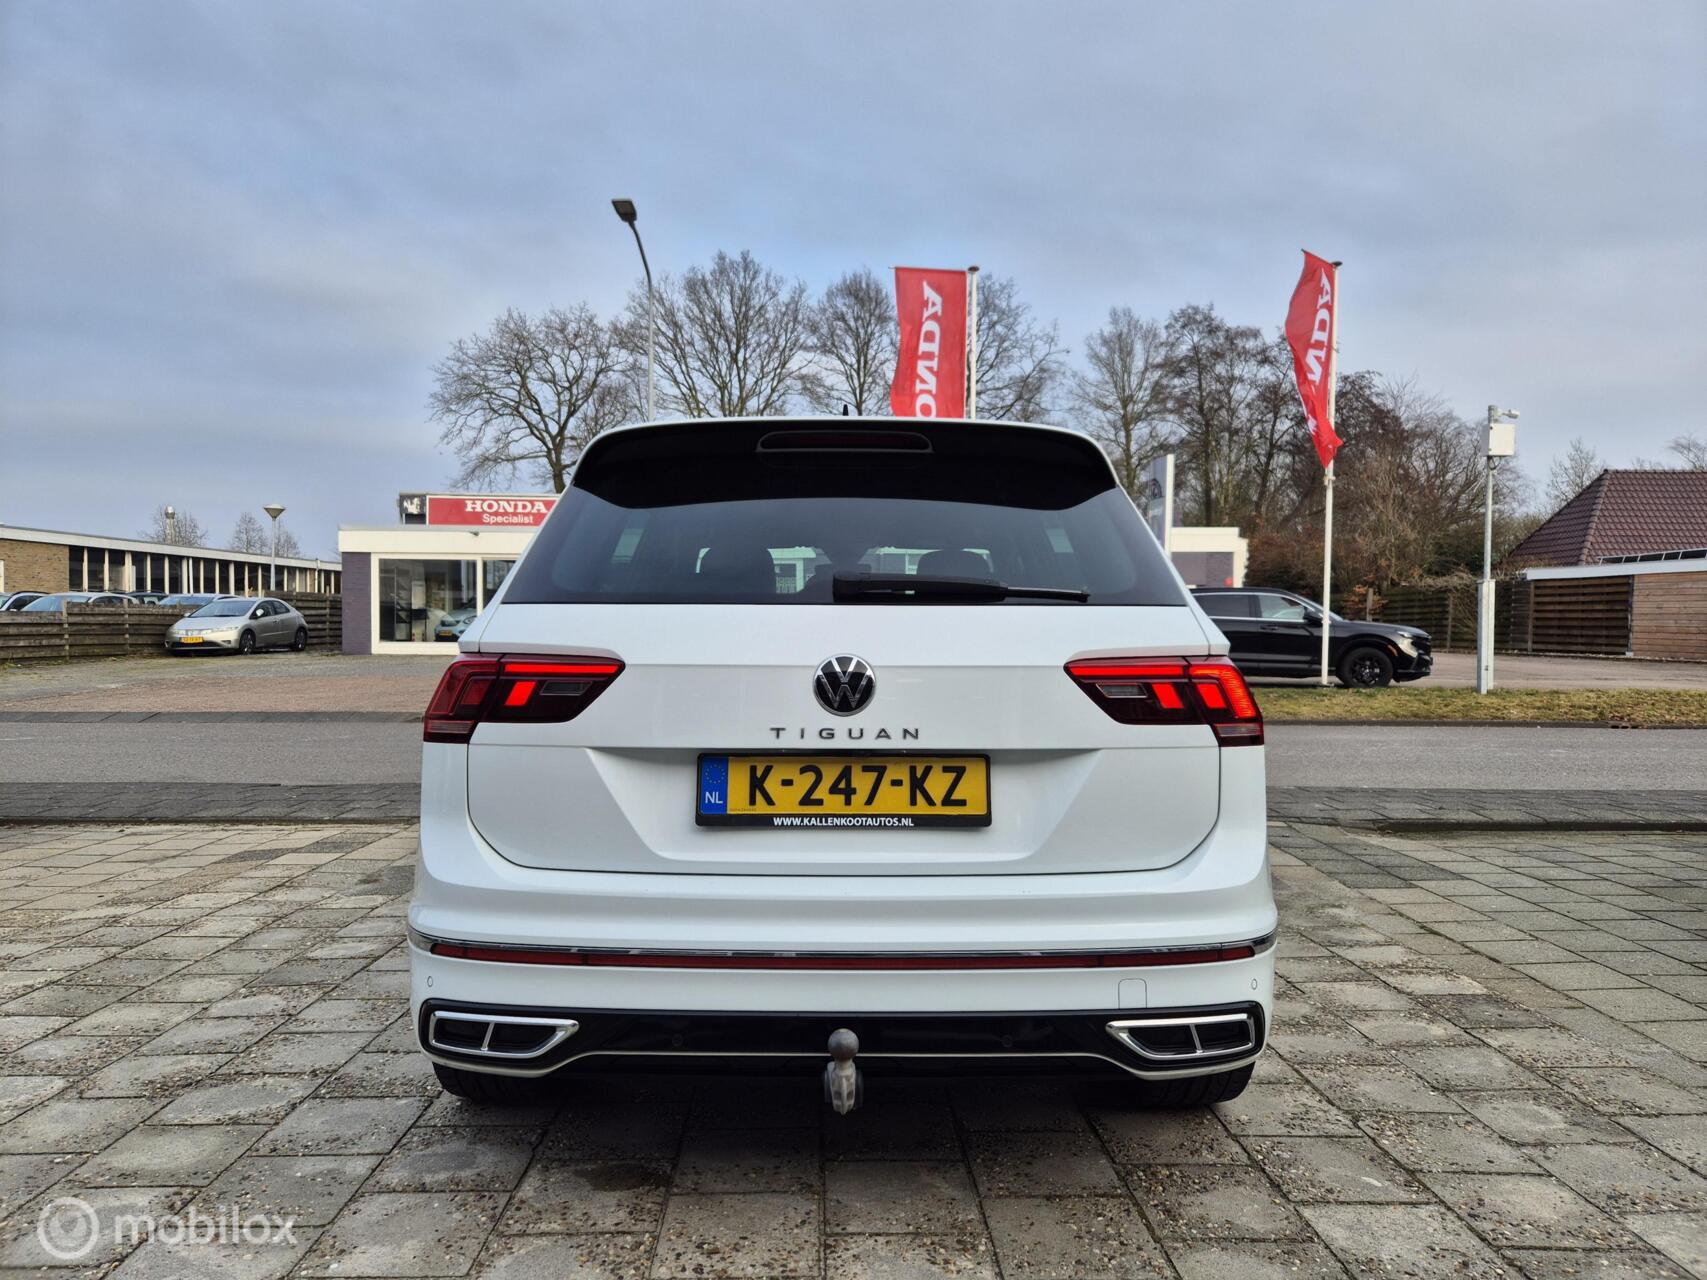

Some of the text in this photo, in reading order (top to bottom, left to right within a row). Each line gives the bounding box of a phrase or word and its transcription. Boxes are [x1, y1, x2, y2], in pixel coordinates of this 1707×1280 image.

[465, 500, 548, 513] HONDA
[482, 513, 534, 525] Specialist
[769, 727, 920, 740] TIGUAN
[704, 764, 968, 807] NL K-247-KZ
[773, 816, 915, 828] WWW.KALLENKOOTAUTOS.NL
